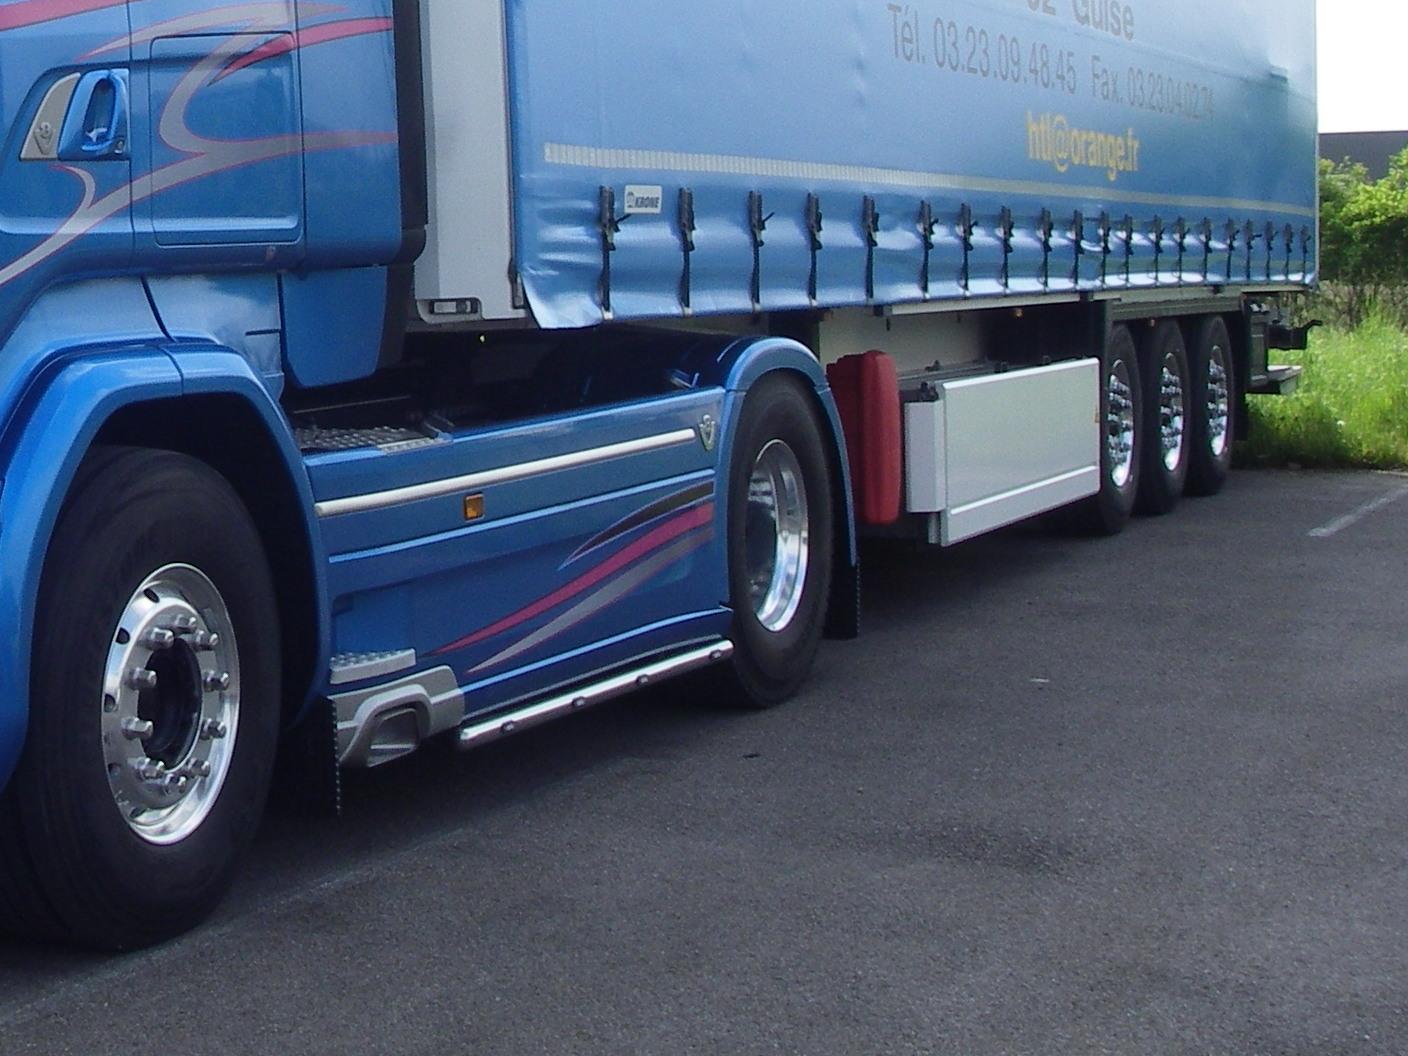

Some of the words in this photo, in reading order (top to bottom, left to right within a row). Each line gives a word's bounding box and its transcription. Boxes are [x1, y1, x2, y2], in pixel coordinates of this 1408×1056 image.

[887, 2, 925, 65] Tél.
[933, 17, 1077, 94] 03.23.09.48.45
[1025, 110, 1139, 182] htl@orange.fr
